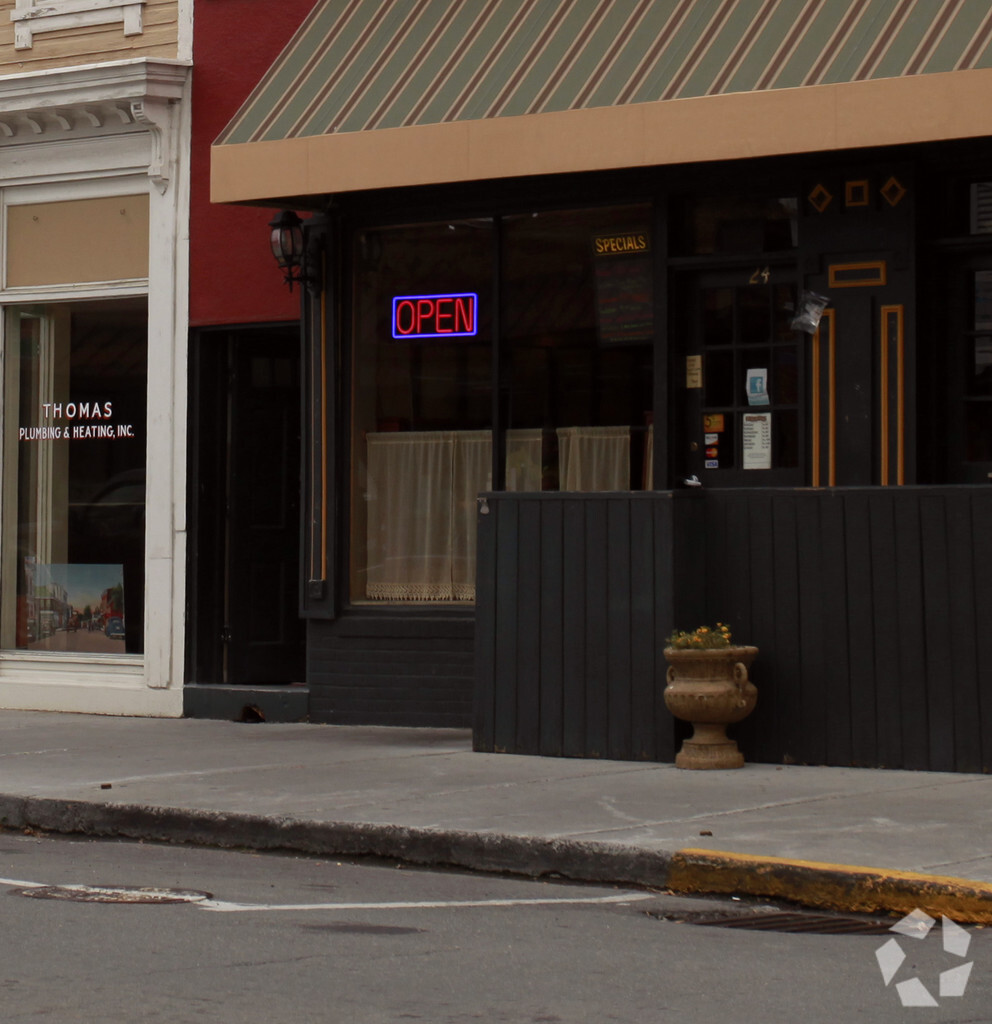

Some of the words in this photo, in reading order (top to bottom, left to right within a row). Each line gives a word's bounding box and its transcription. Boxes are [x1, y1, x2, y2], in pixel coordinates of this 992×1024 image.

[595, 236, 646, 254] SPECIALS
[748, 266, 770, 284] 24
[396, 298, 474, 334] OPEN
[42, 402, 113, 419] THOMAS
[19, 426, 61, 440] PLUMBING
[64, 426, 70, 439] &
[73, 425, 116, 440] HEATING,
[117, 424, 134, 438] INC.
